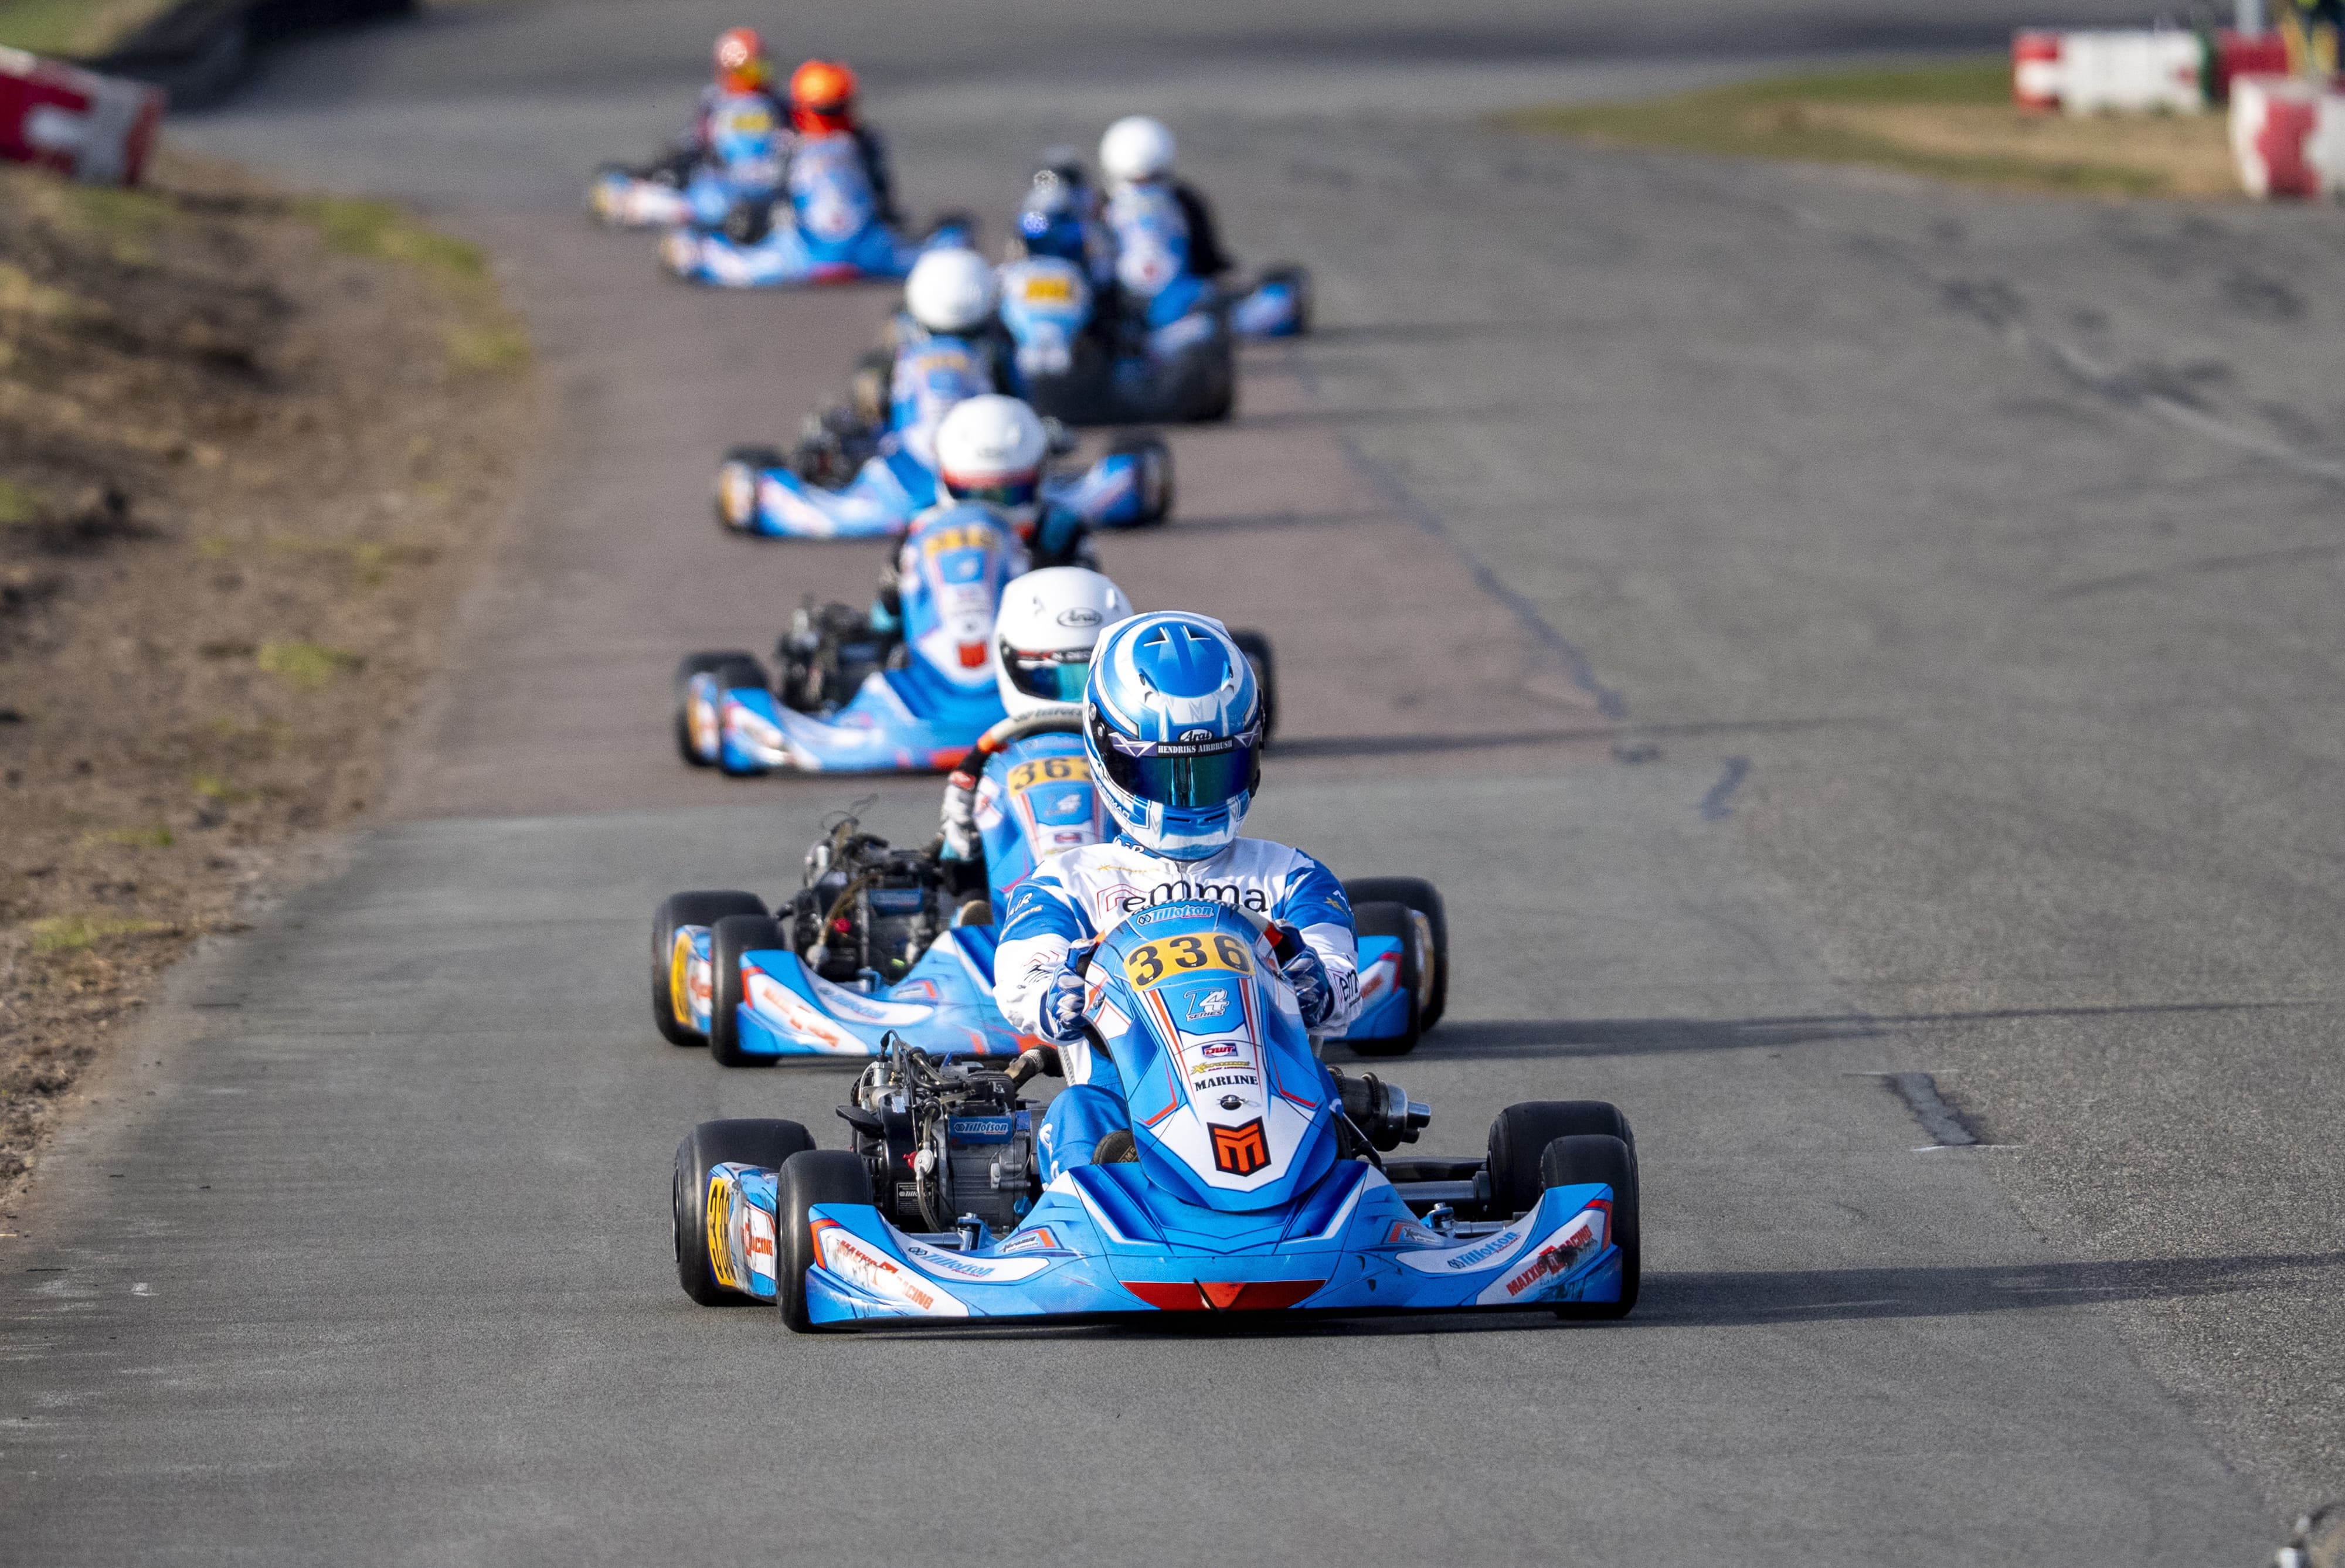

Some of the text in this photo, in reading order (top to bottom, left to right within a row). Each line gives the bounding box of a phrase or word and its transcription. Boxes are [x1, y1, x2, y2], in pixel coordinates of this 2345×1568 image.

[1180, 730, 1211, 742] Arai
[1158, 740, 1232, 753] HENDRIKS AIRBRUSH
[1151, 905, 1212, 921] Tillotson
[1129, 936, 1250, 986] 336
[1188, 1011, 1224, 1020] SERIES
[1194, 1075, 1259, 1091] MARLINE
[964, 1122, 1007, 1131] Tillotson
[1456, 1232, 1517, 1266] Tillotson
[922, 1253, 995, 1276] Tillotson
